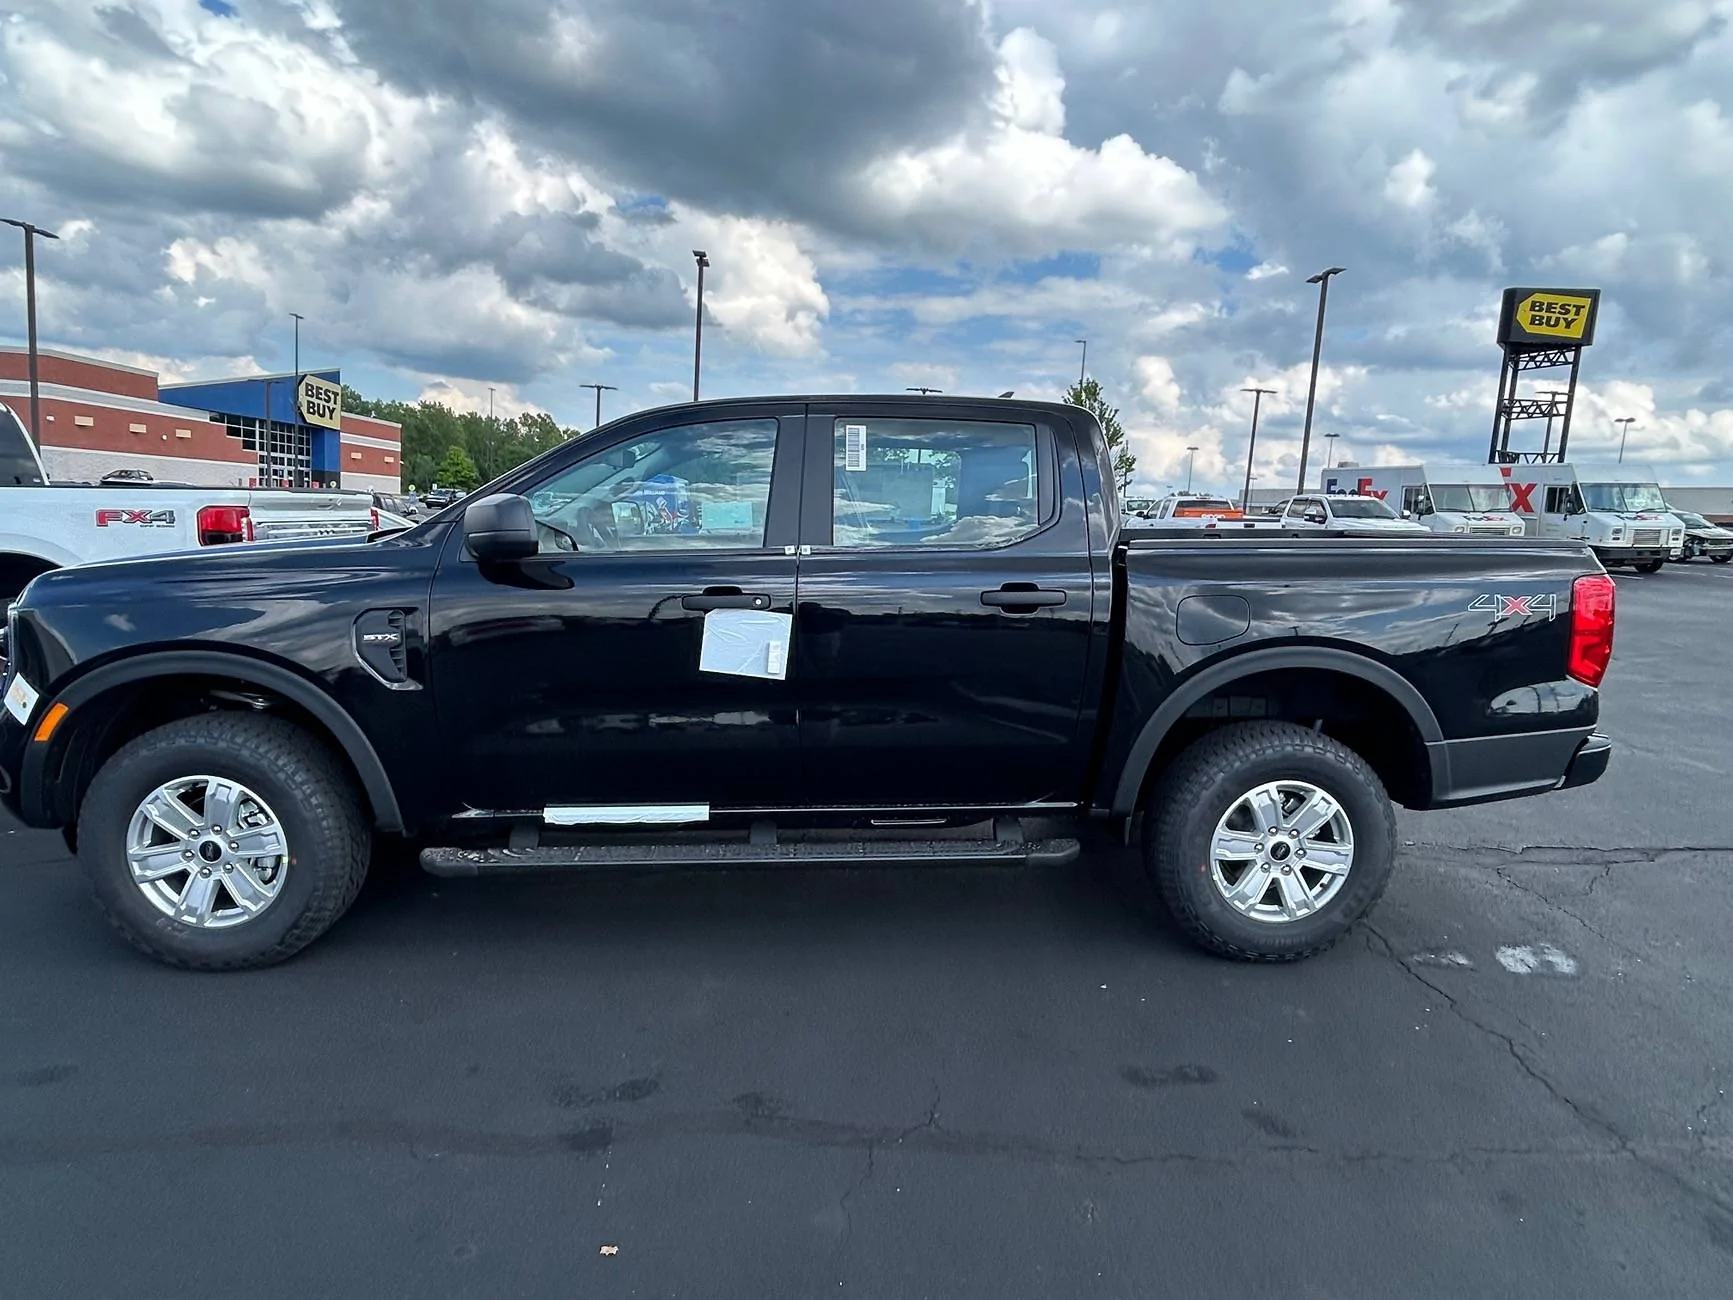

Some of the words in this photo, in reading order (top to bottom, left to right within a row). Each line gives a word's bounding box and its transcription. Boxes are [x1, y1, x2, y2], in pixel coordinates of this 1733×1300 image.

[1529, 300, 1585, 316] BEST
[1529, 314, 1577, 329] BUY
[304, 382, 339, 405] BEST
[306, 400, 336, 421] BUY
[96, 509, 175, 527] FX4
